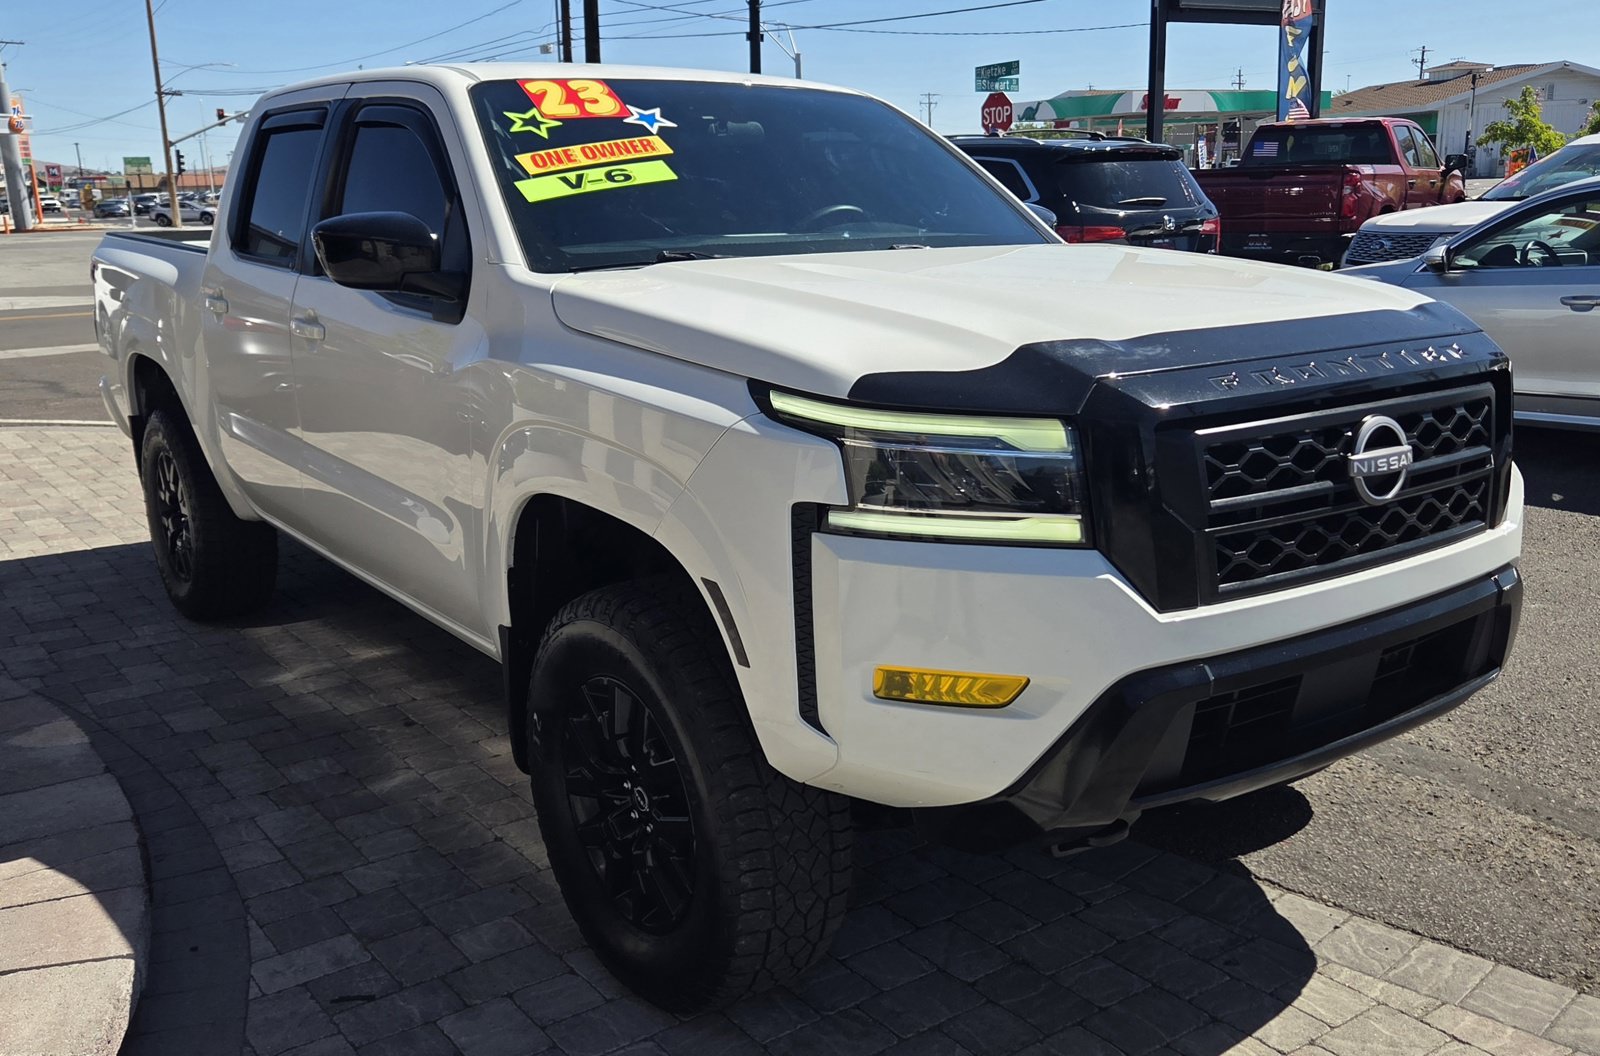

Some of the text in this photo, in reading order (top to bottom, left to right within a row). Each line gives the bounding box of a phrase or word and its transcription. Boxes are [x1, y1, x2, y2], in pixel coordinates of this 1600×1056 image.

[980, 64, 1007, 78] Kietzke
[981, 79, 1010, 91] Stewart
[523, 79, 621, 117] 23
[983, 105, 1011, 125] STOP
[529, 137, 657, 169] ONE OWNER
[556, 167, 634, 190] V-6
[1353, 451, 1413, 473] NISSAN
